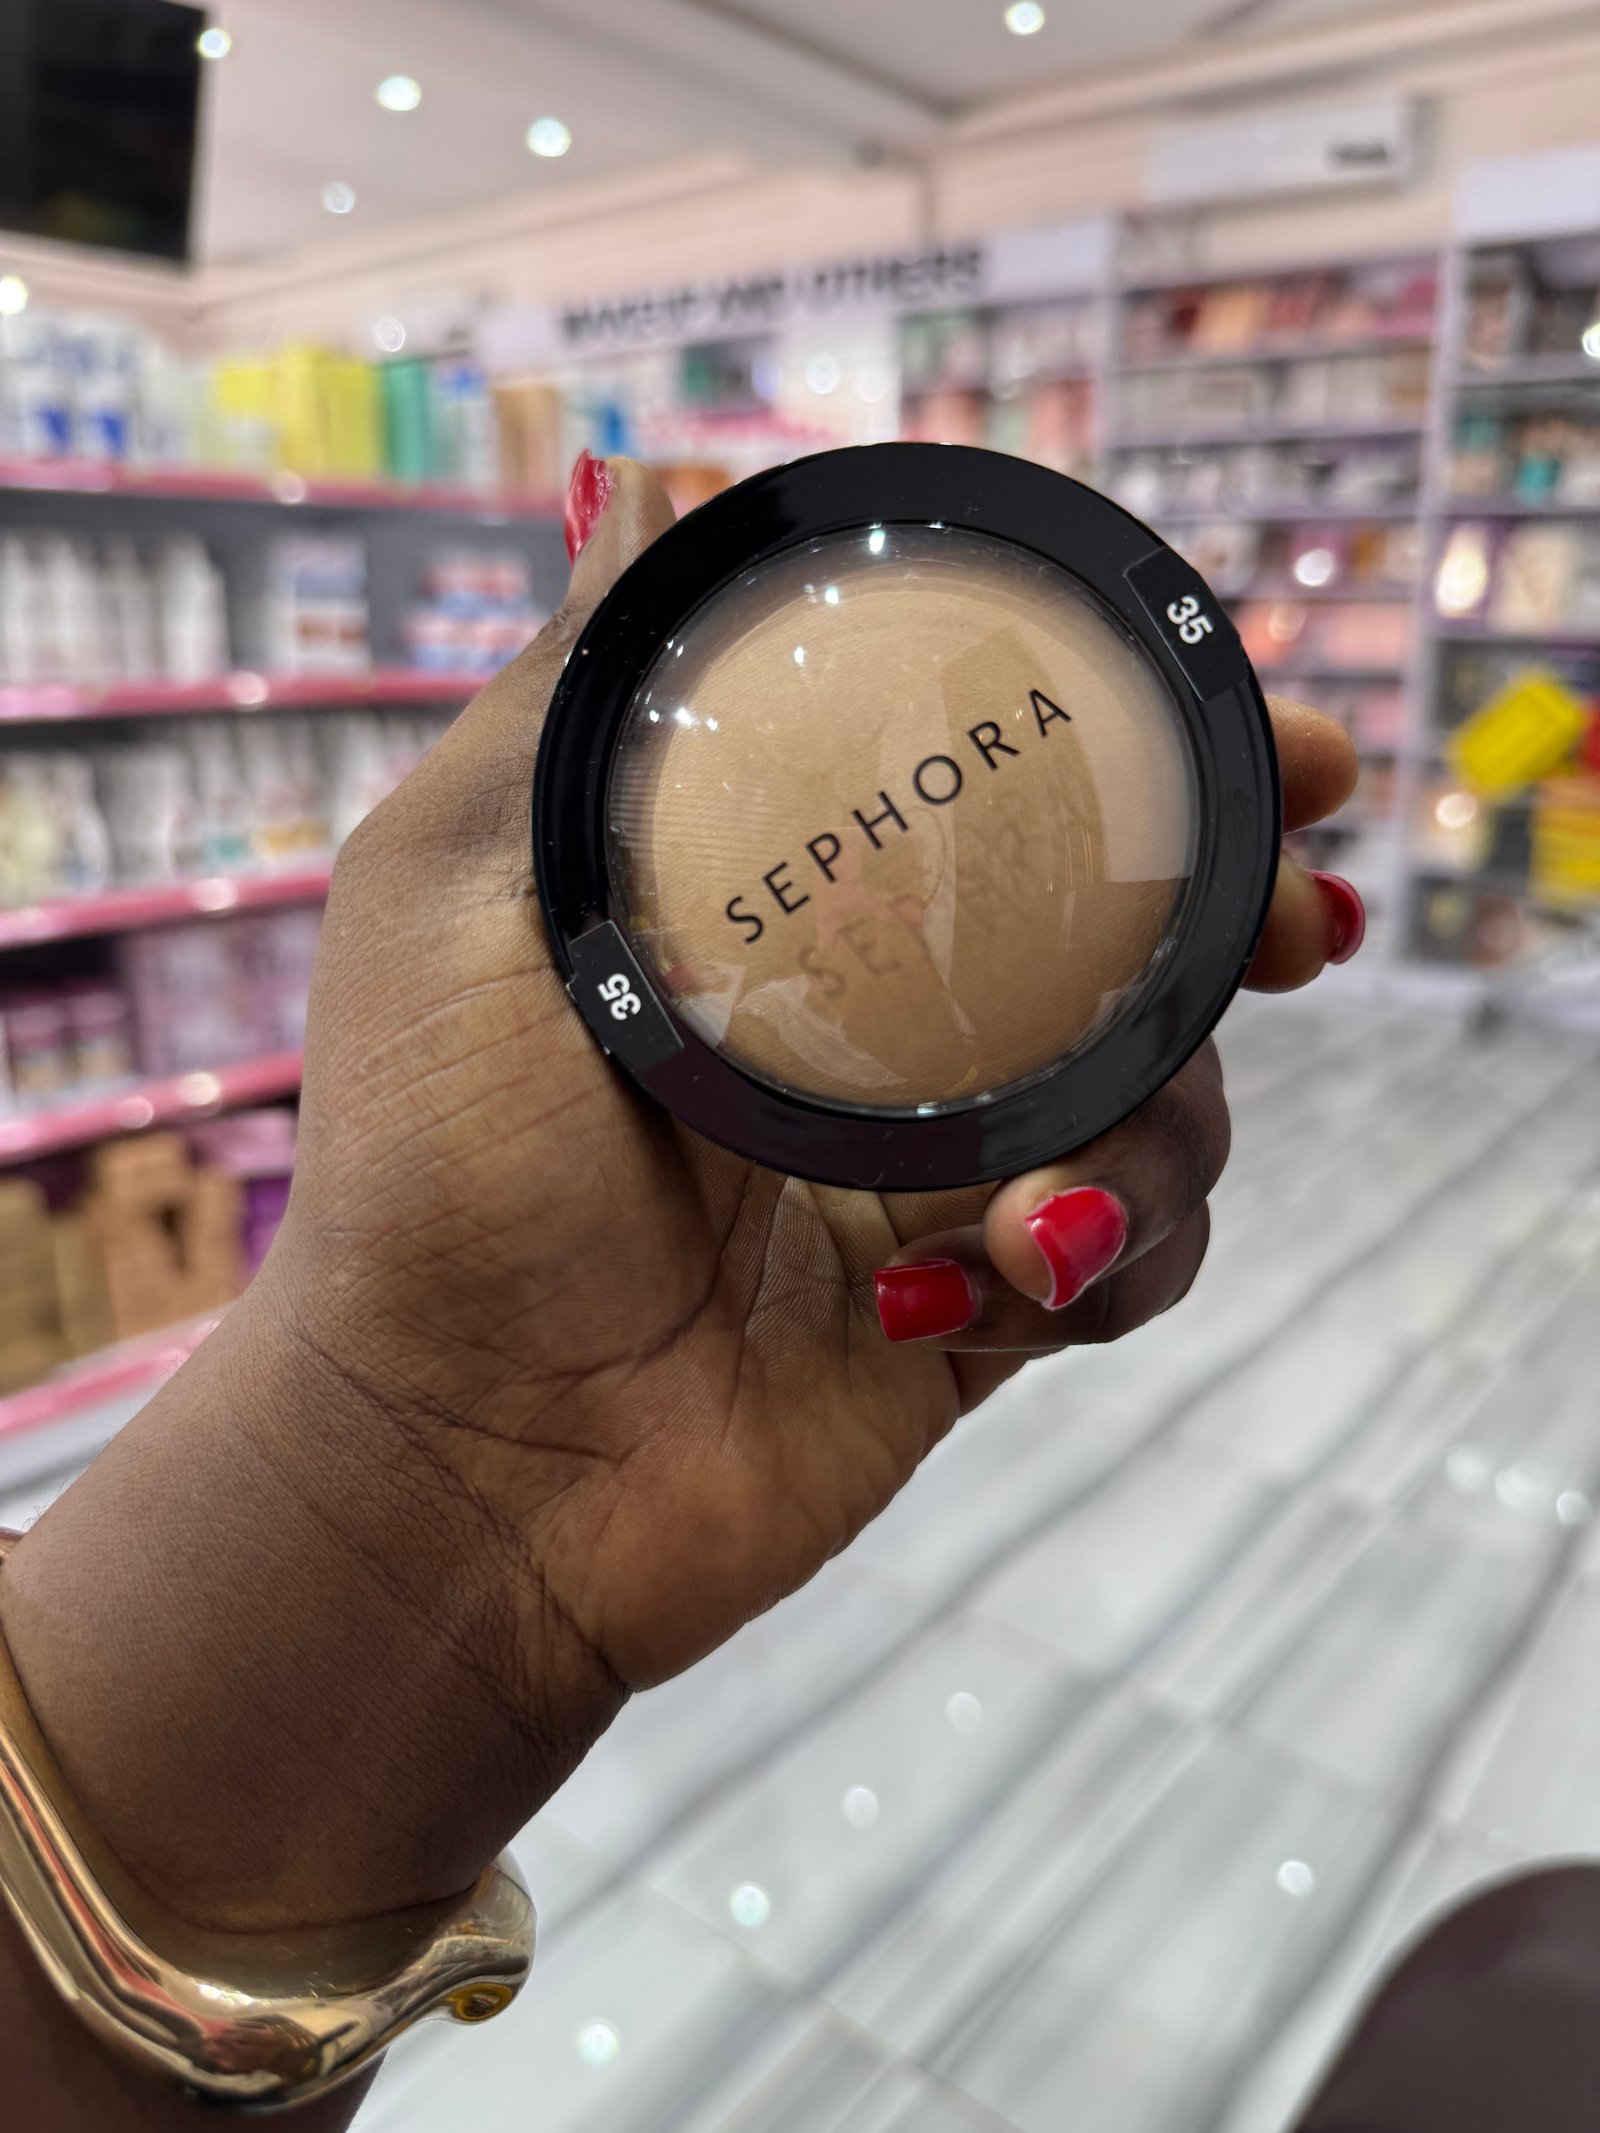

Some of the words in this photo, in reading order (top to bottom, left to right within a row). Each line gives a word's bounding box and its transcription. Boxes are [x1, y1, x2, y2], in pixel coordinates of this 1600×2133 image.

[1166, 596, 1214, 645] 35
[725, 688, 1073, 943] SEPHORA
[597, 973, 642, 1020] 35
